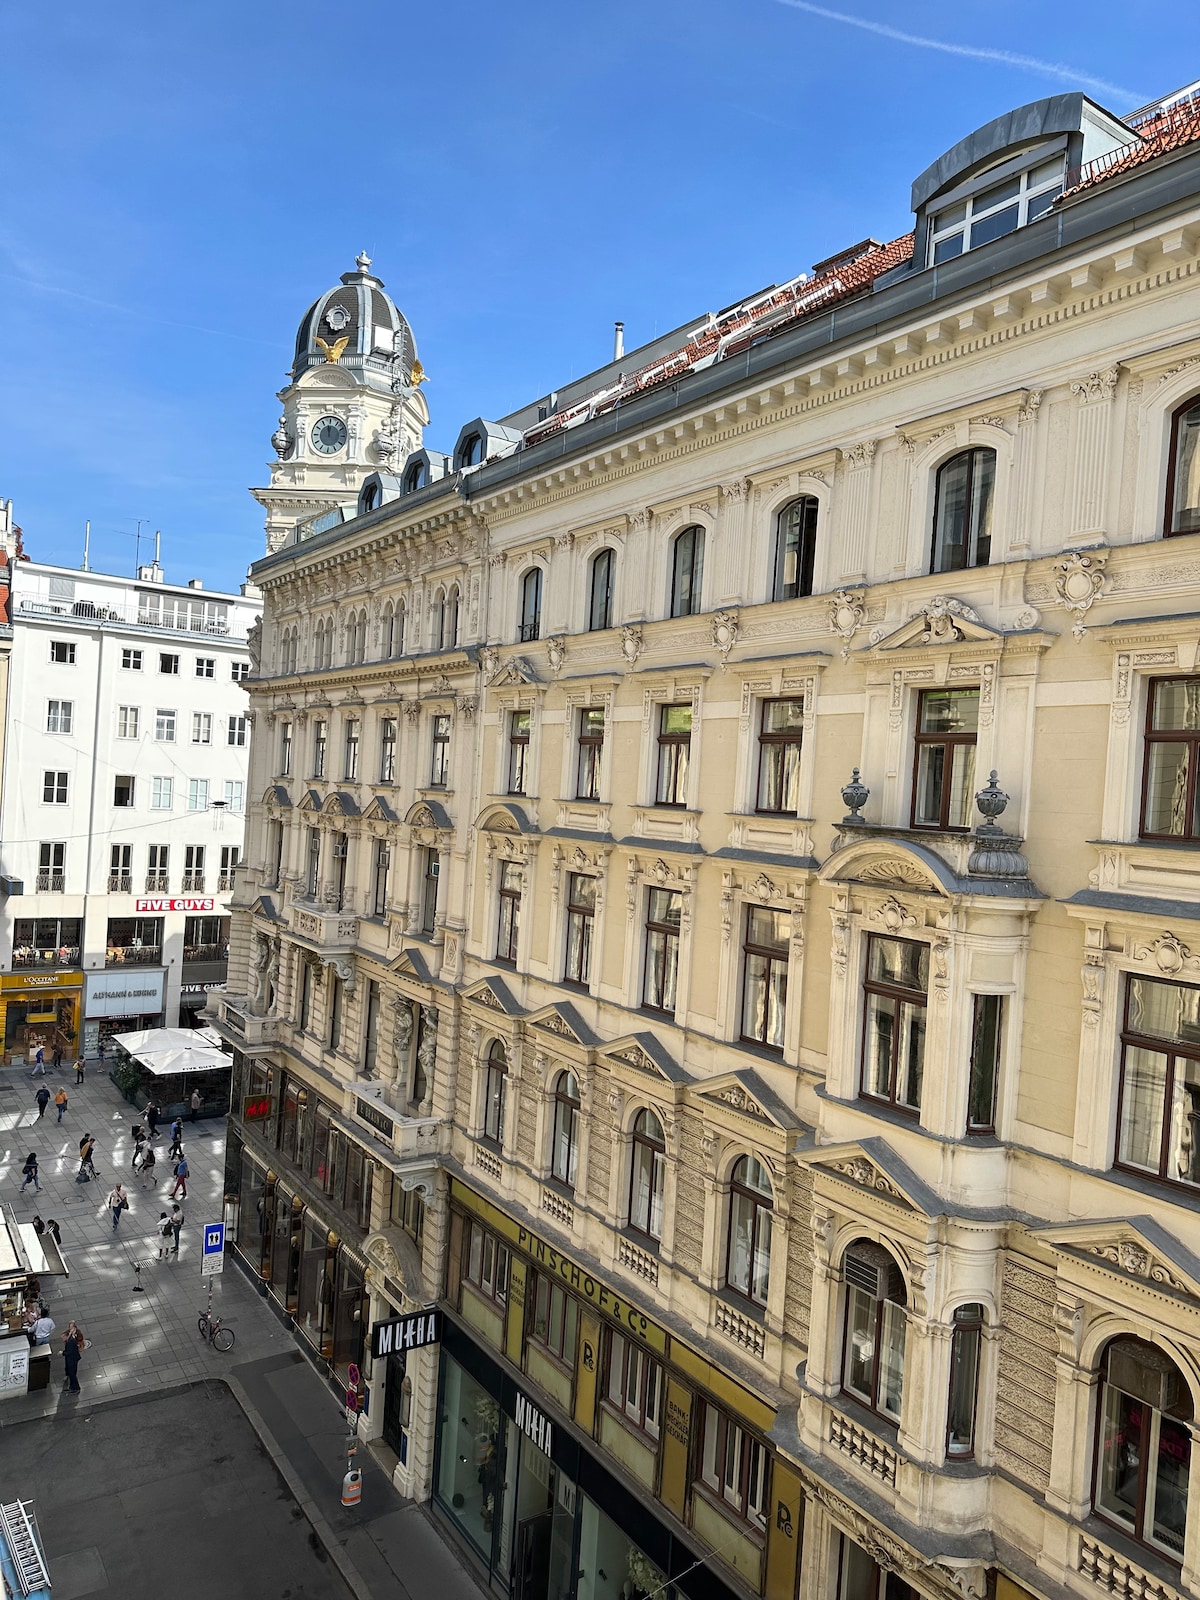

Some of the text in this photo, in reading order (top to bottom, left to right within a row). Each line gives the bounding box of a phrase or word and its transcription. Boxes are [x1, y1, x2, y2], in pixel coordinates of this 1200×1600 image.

[138, 900, 213, 911] FIVE GUYS
[180, 984, 202, 992] FIVE
[518, 1228, 609, 1305] PINSCHOF
[613, 1301, 621, 1321] &
[379, 1314, 435, 1355] MUKHA
[515, 1391, 552, 1458] MUKHA
